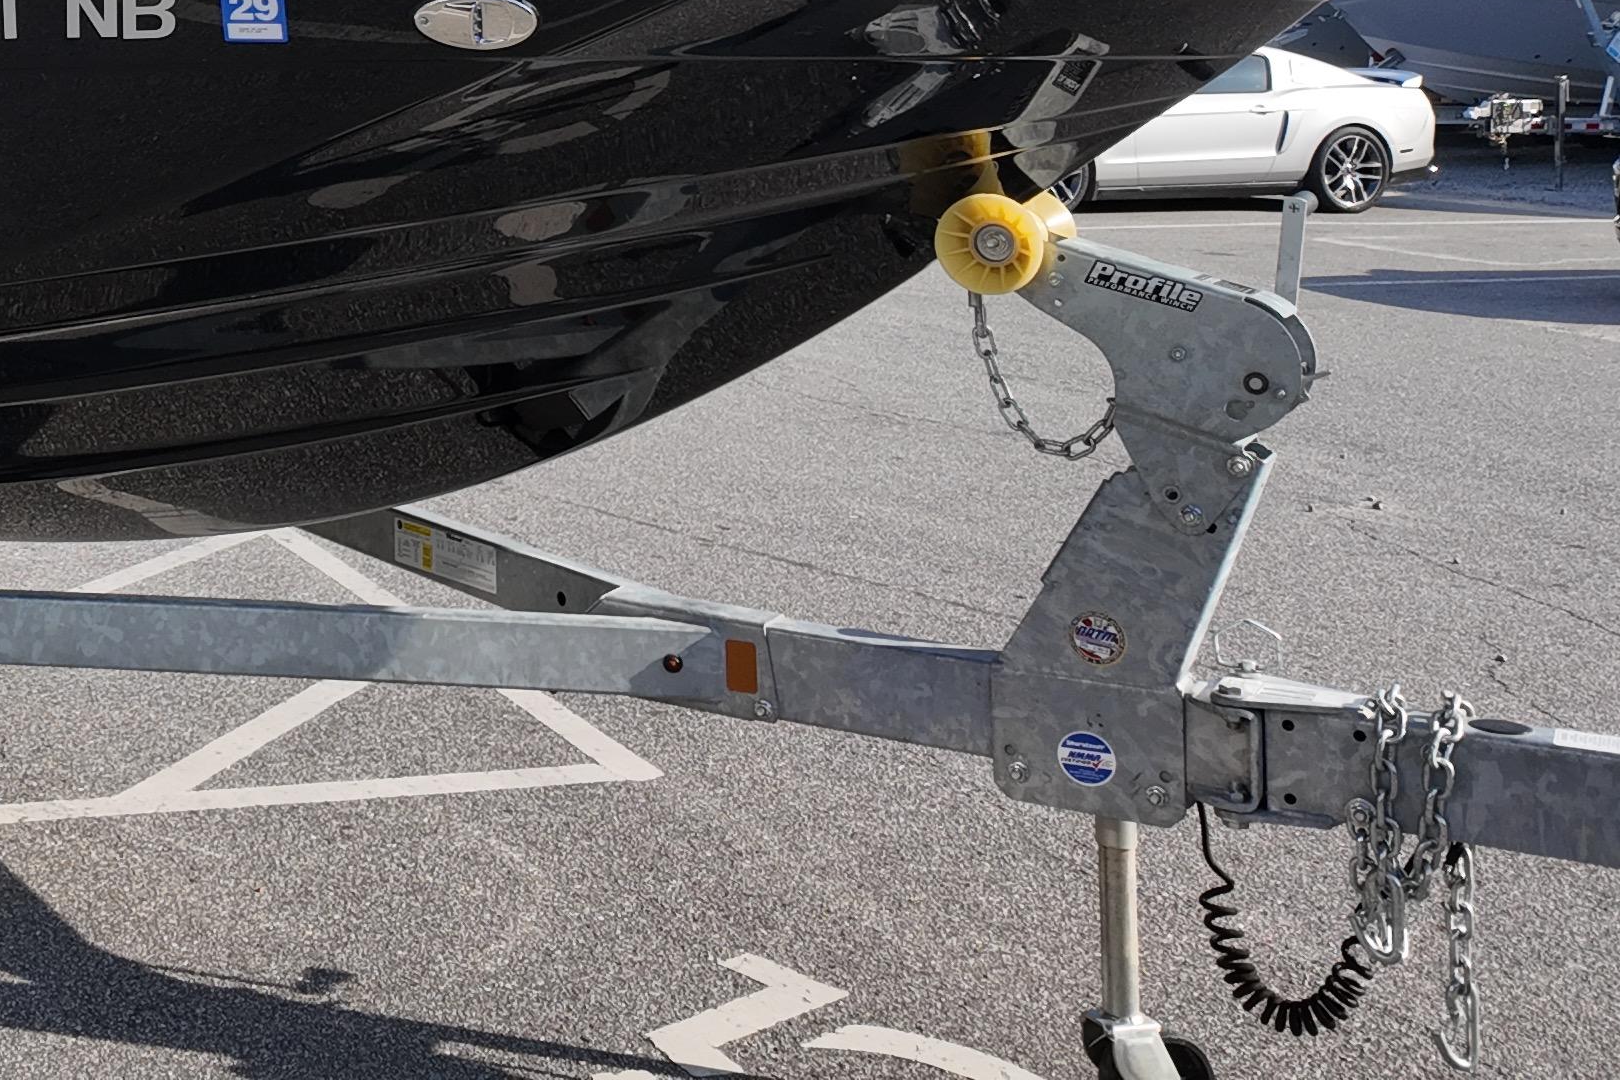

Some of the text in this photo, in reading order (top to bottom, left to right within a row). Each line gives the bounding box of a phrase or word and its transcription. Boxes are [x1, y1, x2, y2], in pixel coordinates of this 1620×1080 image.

[1087, 277, 1195, 312] PERFORMANCE WINCH
[1089, 261, 1202, 306] Profile
